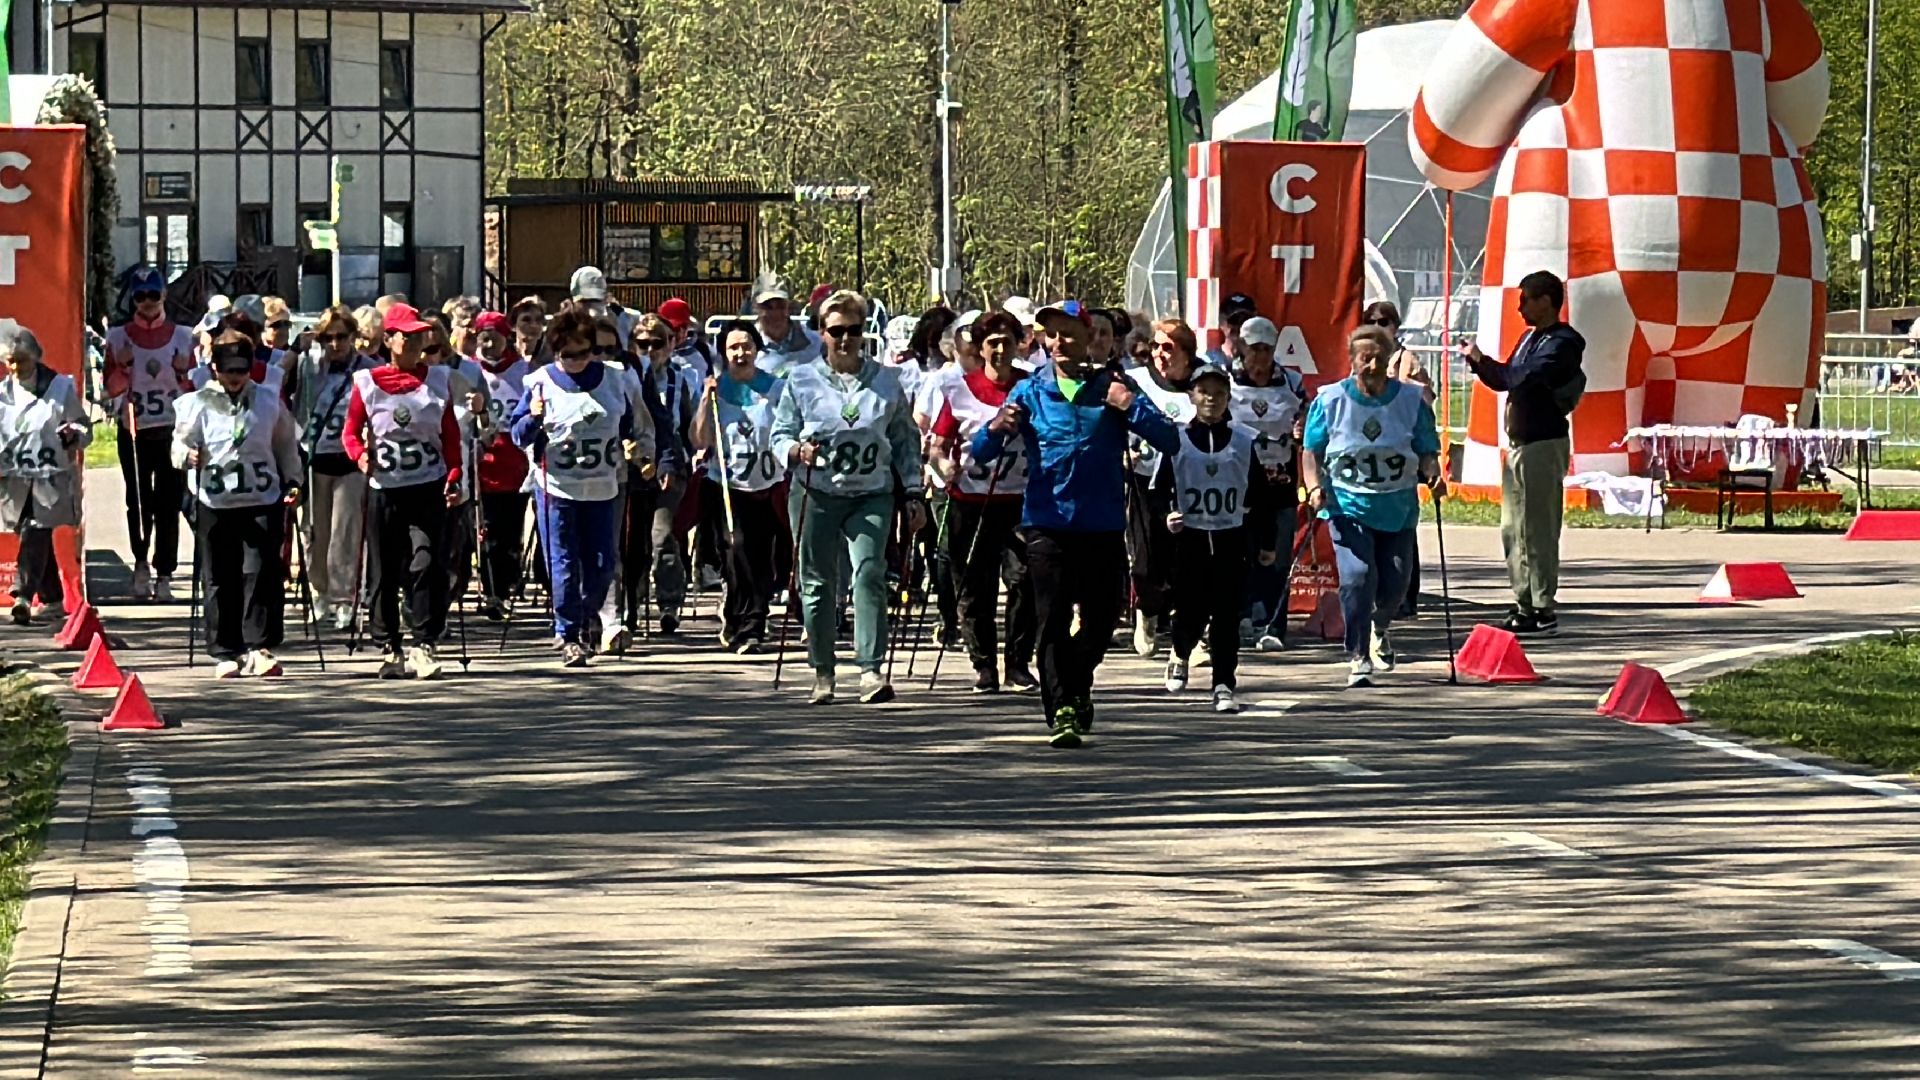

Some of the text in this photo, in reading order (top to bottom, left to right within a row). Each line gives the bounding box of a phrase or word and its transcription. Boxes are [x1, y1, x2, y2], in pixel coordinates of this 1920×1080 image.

[0, 151, 32, 345] СТ
[377, 439, 440, 472] 359
[722, 450, 775, 481] 70
[204, 462, 273, 495] 315
[1185, 488, 1238, 516] 200
